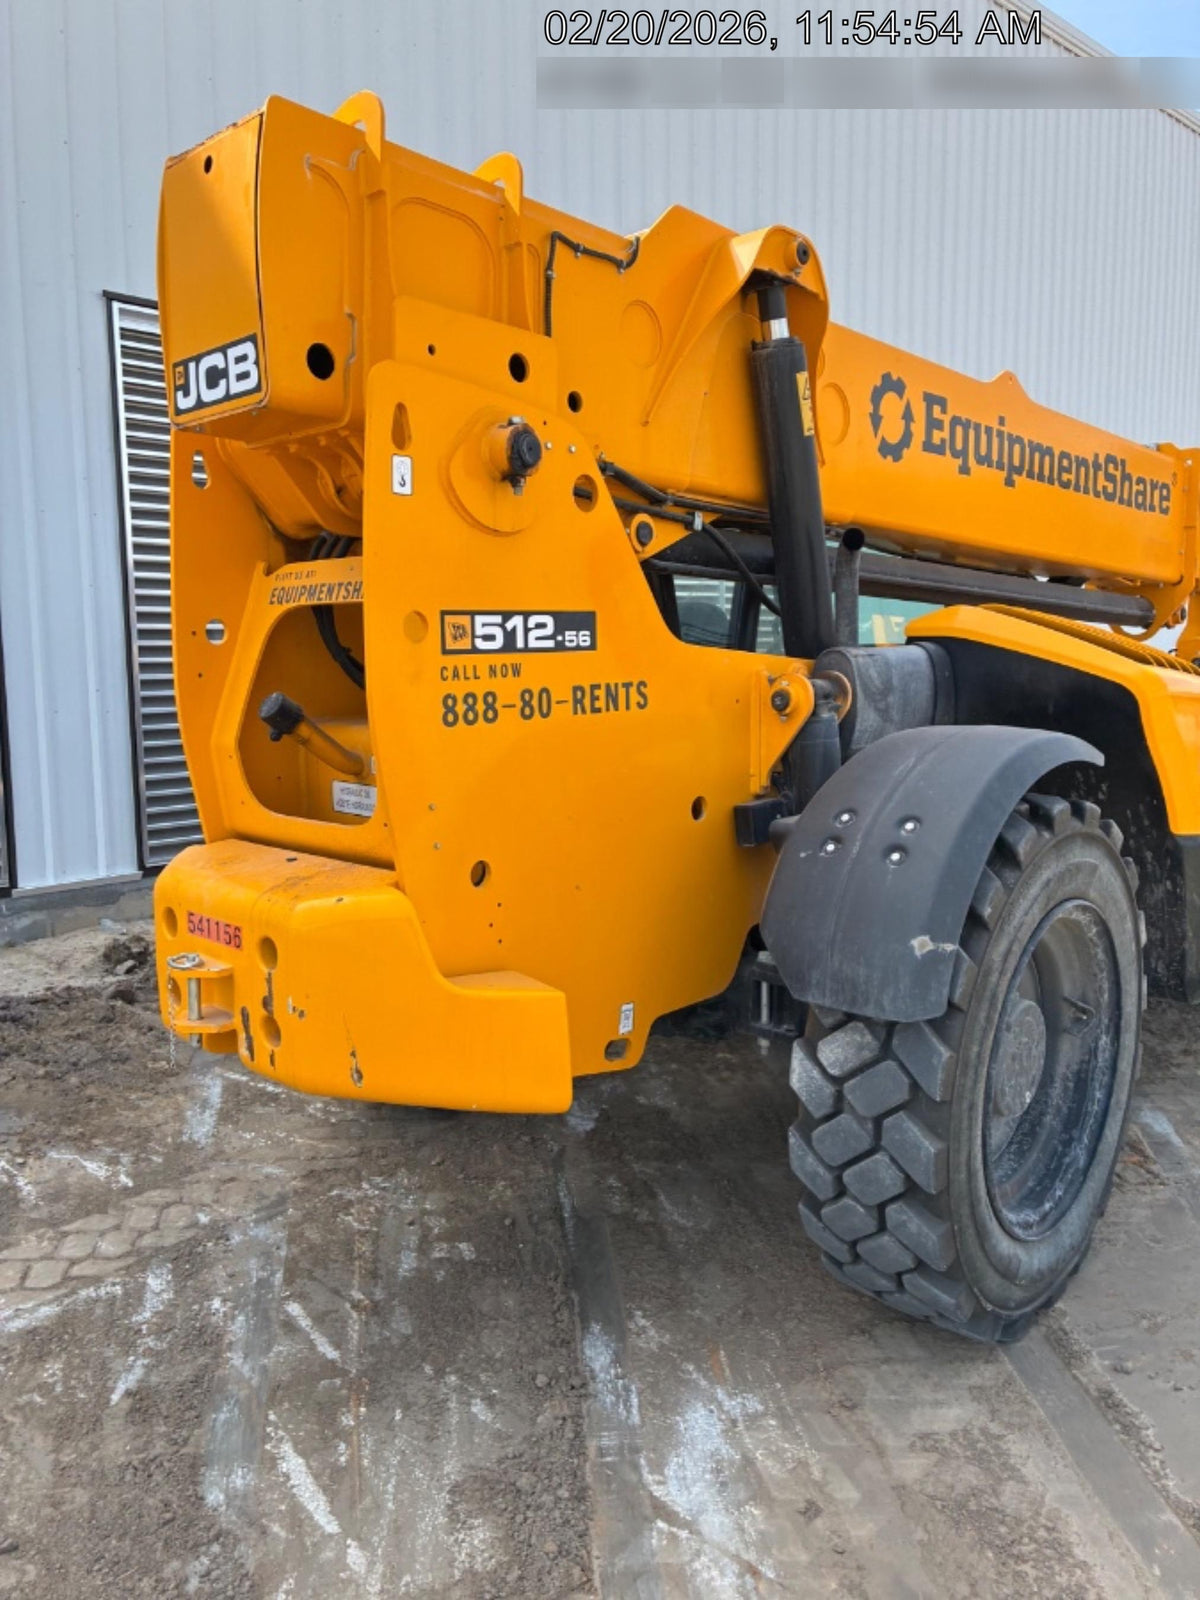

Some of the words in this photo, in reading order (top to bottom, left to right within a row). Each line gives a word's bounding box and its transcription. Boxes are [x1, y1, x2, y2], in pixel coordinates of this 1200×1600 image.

[176, 341, 258, 410] JCB
[268, 580, 364, 605] EQUIPMENTSH
[440, 664, 481, 682] CALL
[488, 662, 523, 680] NOW
[441, 680, 649, 728] 888-80-RENTS
[187, 912, 243, 949] 541156
